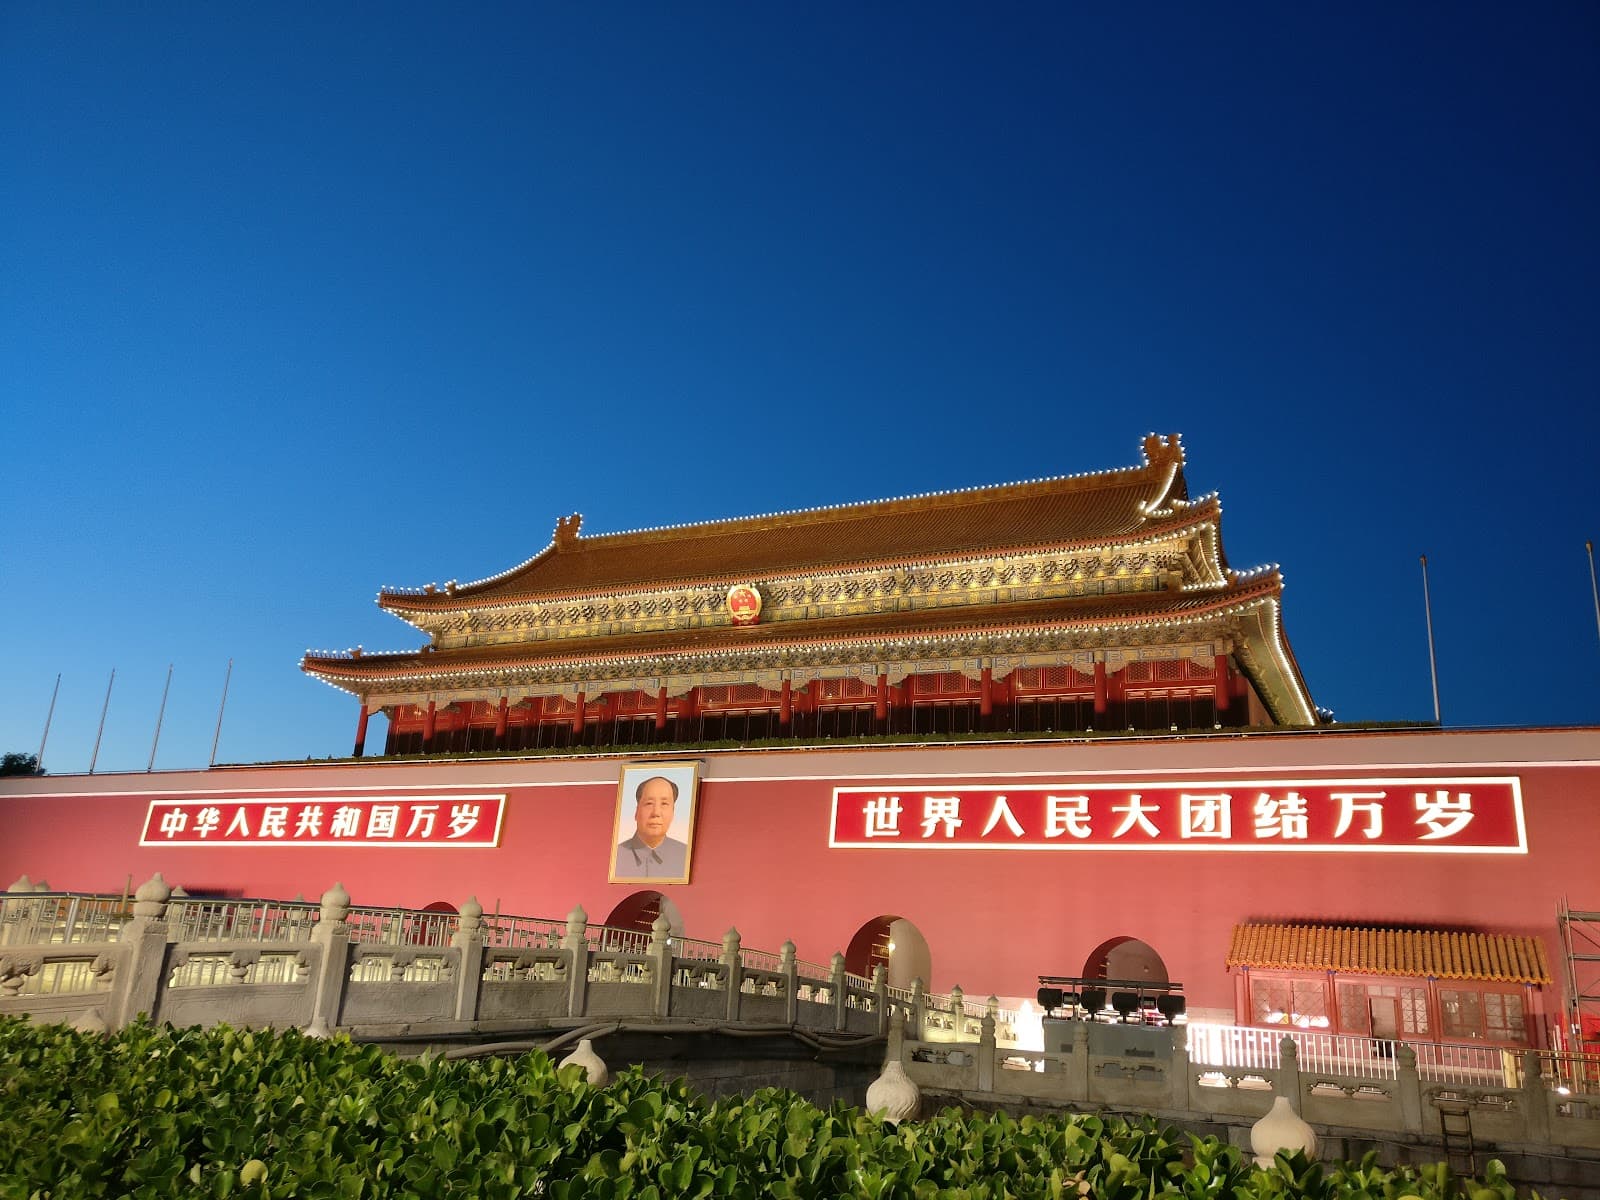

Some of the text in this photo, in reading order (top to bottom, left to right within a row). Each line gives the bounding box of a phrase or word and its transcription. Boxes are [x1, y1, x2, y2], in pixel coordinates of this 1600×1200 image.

[159, 803, 481, 839] 中华人民共和国万岁
[862, 790, 1475, 840] 世界人民大团结万岁
